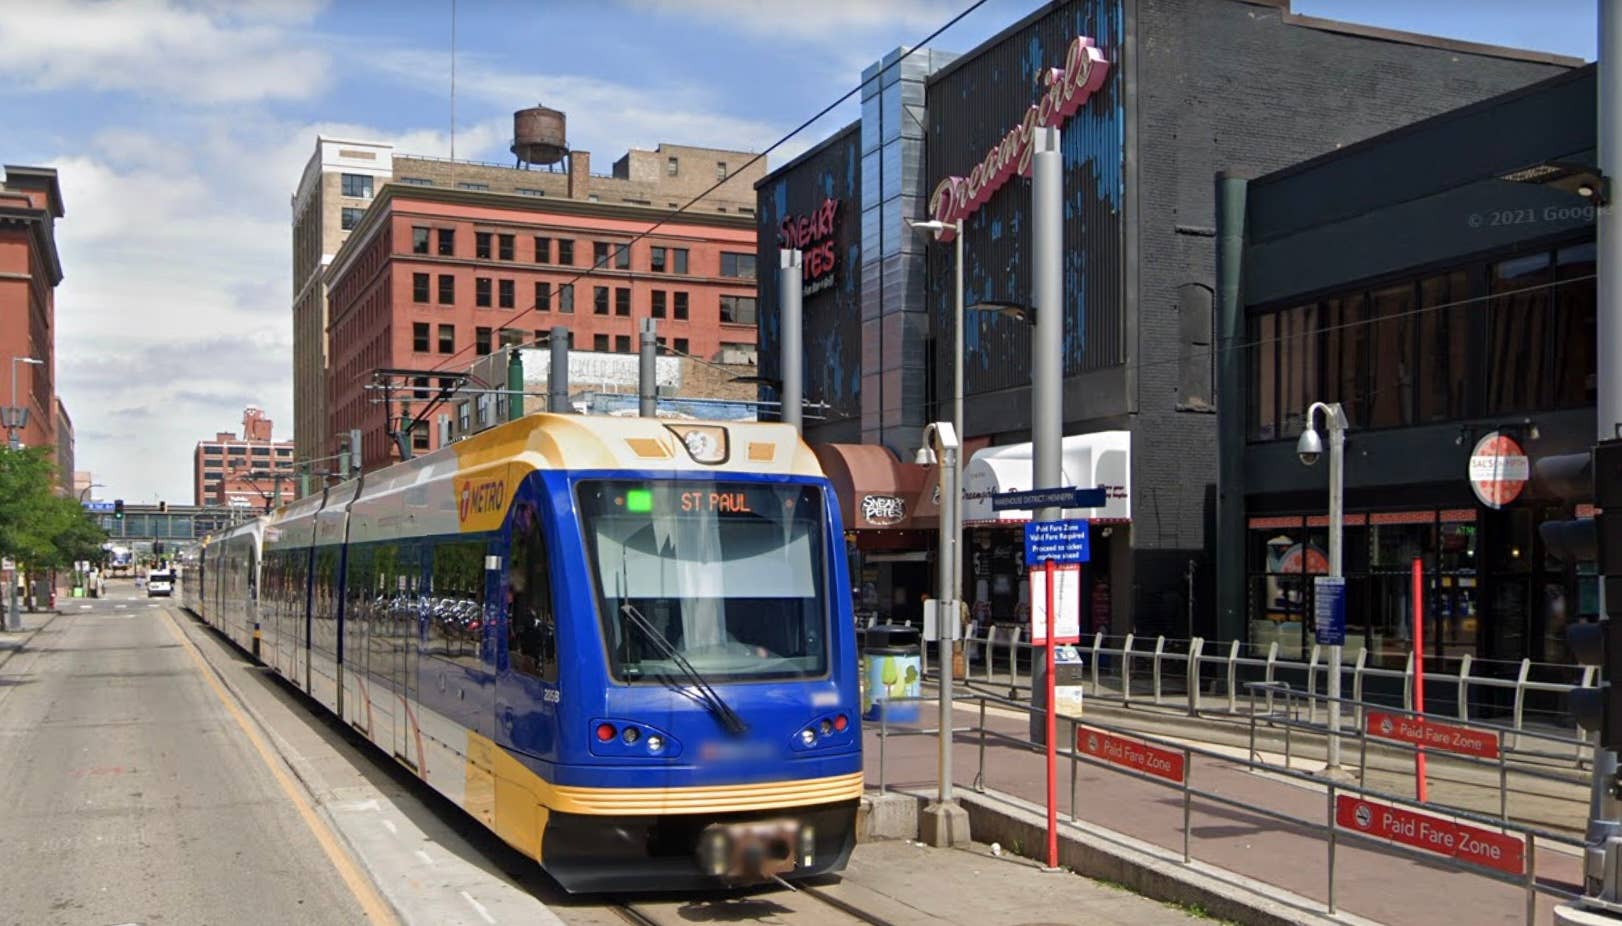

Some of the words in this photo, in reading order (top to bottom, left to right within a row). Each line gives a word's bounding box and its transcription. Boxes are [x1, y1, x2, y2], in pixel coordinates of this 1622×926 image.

[929, 35, 1110, 242] Dreamgirls
[778, 198, 838, 250] SNEAKY
[803, 240, 835, 281] TE'S
[472, 480, 504, 513] METRO
[681, 491, 703, 512] ST
[709, 491, 752, 512] PAUL
[1035, 524, 1048, 532] Paid
[1049, 524, 1062, 532] Fare
[1045, 533, 1058, 541] Fare
[1400, 722, 1423, 738] Paid
[1426, 728, 1450, 745] Fare
[1453, 733, 1482, 751] Zone
[1104, 740, 1122, 760] Paid
[1124, 746, 1144, 764] Fare
[1147, 752, 1171, 772] Zone
[1382, 813, 1415, 837] Paid
[1420, 823, 1454, 847] Fare
[1458, 832, 1501, 859] Zone
